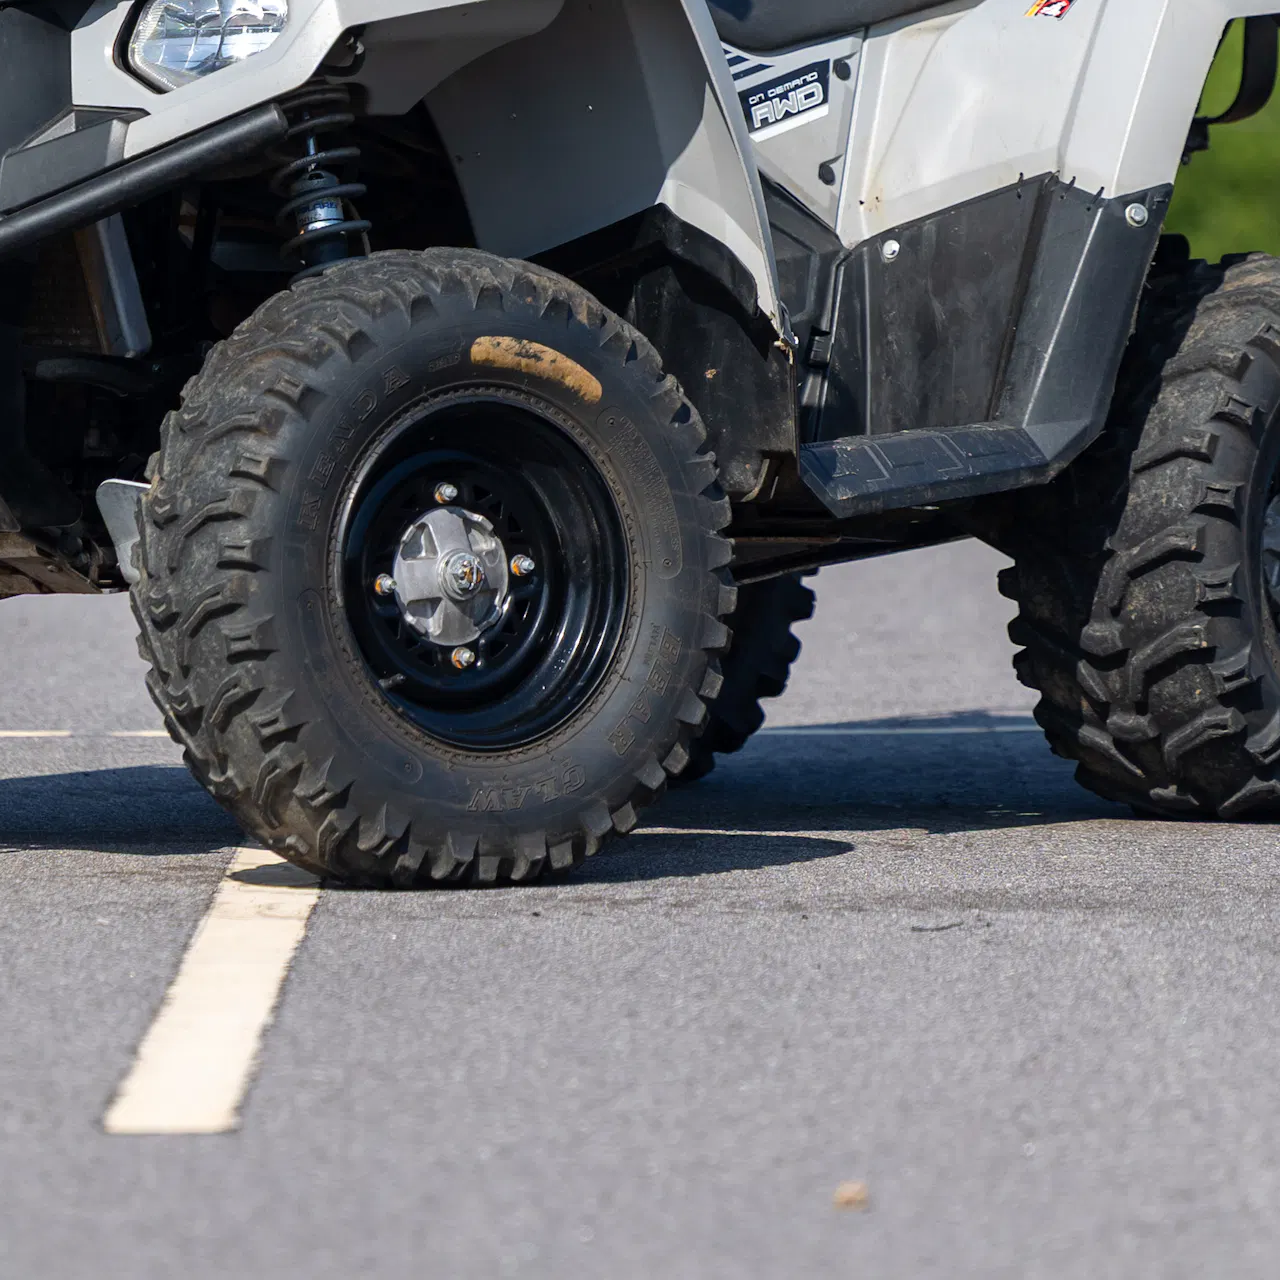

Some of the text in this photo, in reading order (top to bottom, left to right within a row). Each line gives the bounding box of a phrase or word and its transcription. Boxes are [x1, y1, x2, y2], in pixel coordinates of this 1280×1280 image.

[748, 71, 818, 105] ON DEMAND
[750, 81, 824, 128] AWD
[297, 364, 411, 531] KENDA
[466, 625, 683, 813] BEAR CLAW
